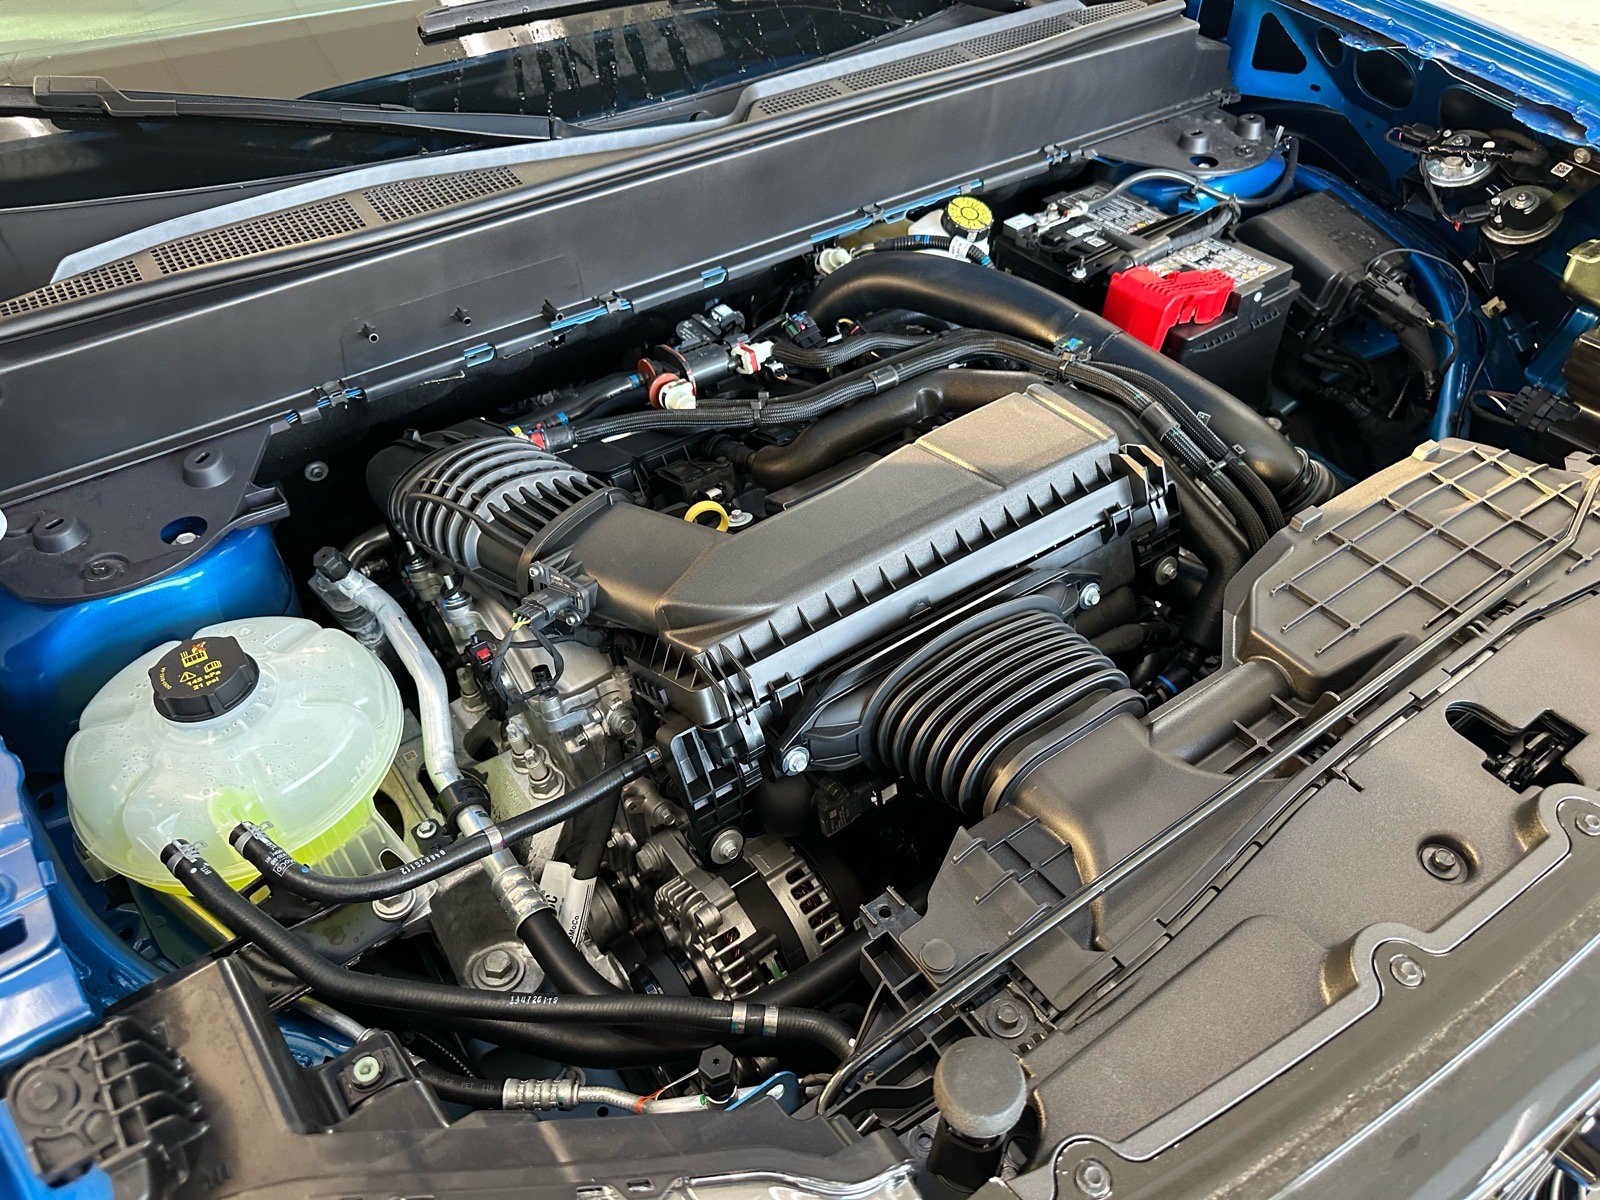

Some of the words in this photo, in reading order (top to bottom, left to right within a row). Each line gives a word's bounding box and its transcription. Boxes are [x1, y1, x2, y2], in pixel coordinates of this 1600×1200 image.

[204, 670, 221, 679] kPa
[193, 683, 204, 691] 21
[205, 676, 219, 686] psi
